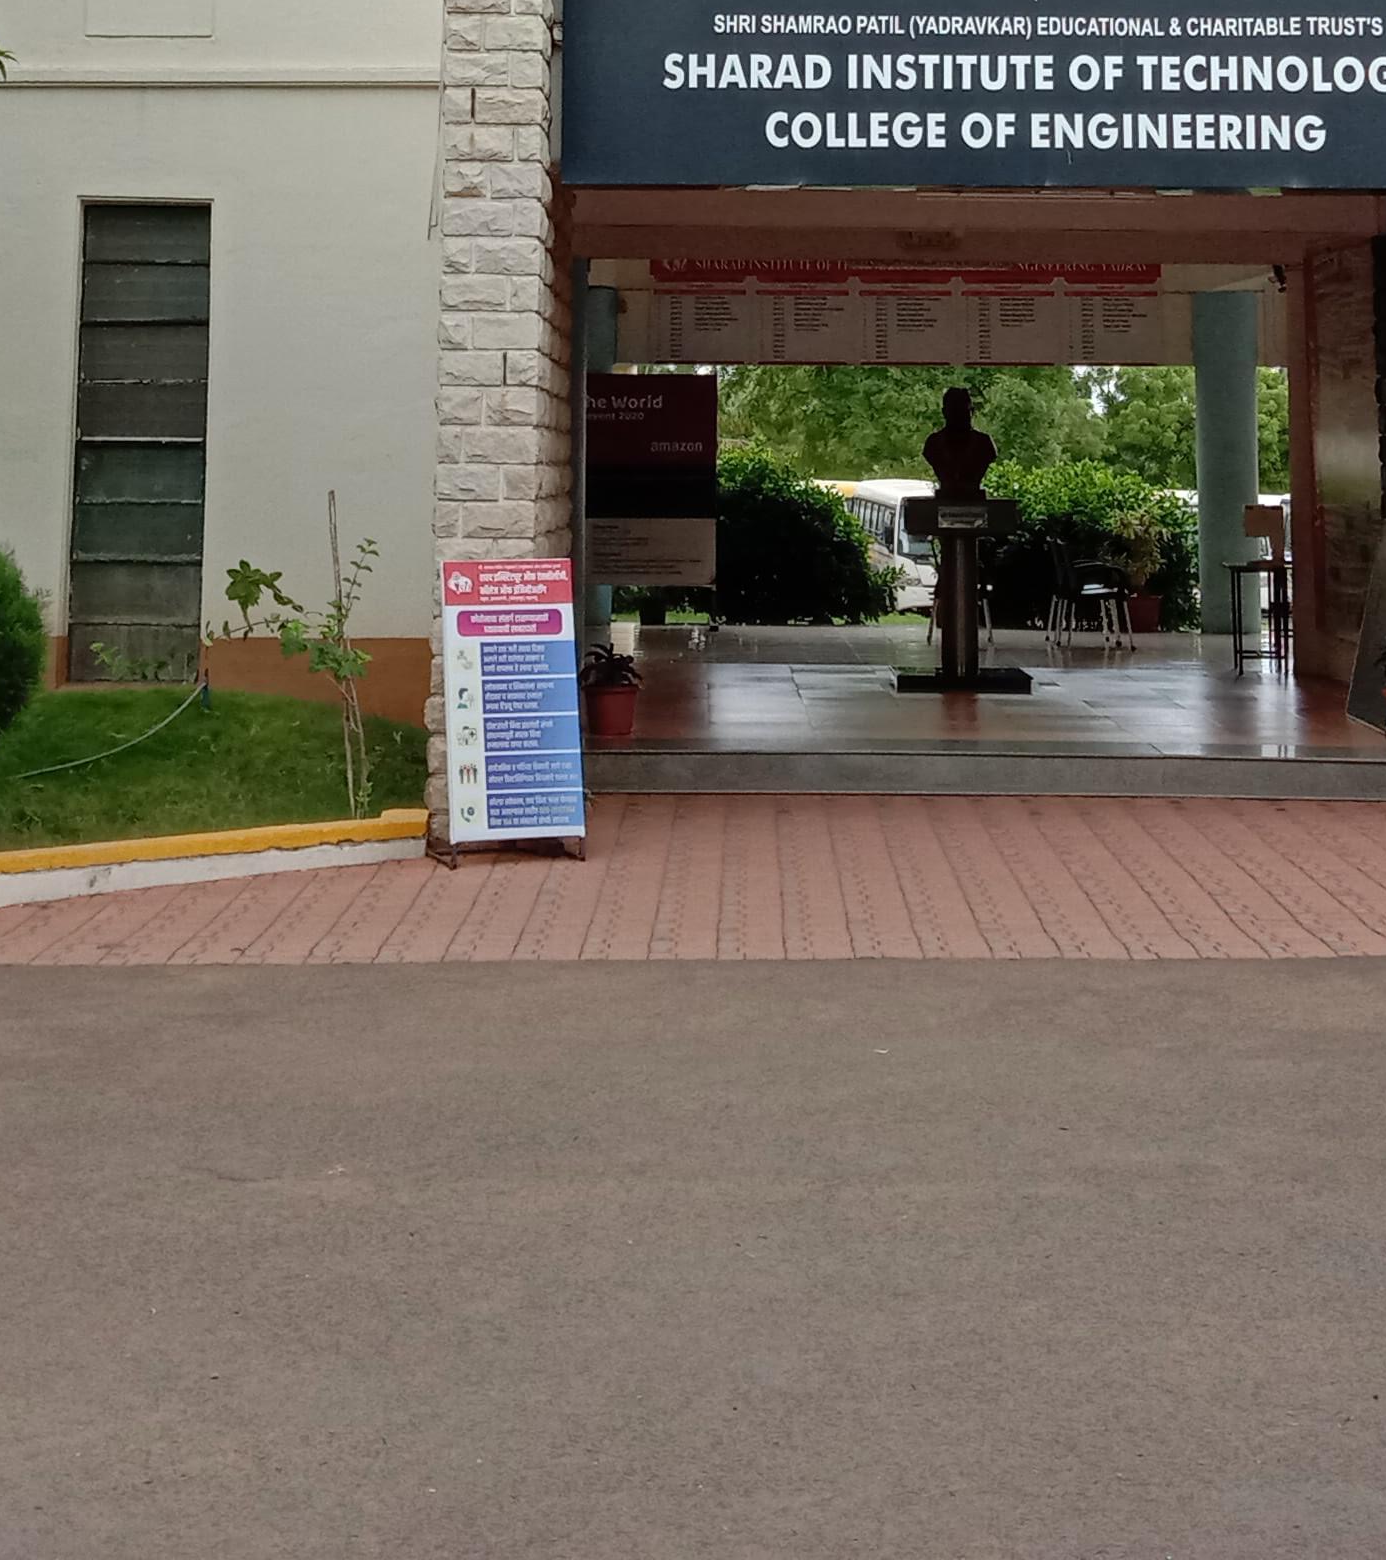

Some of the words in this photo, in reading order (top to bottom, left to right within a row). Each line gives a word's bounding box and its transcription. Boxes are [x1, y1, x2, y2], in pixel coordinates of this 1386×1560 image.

[713, 14, 757, 34] SHRI
[760, 14, 852, 35] SHAMRAO
[856, 15, 906, 35] PATIL
[909, 15, 1032, 40] (YADRAVKAR)
[1036, 16, 1164, 37] EDUCATIONAL
[1168, 16, 1183, 37] &
[1186, 16, 1302, 37] CHARITABLE
[1305, 16, 1384, 37] TRUST'S
[662, 52, 832, 90] SHARAD
[847, 53, 1054, 91] INSTITUTE
[1068, 54, 1124, 91] OF
[765, 110, 947, 149] COLLEGE
[961, 111, 1016, 149] OF
[1030, 112, 1327, 152] ENGINEERING
[611, 394, 663, 409] World
[650, 441, 704, 453] amazon
